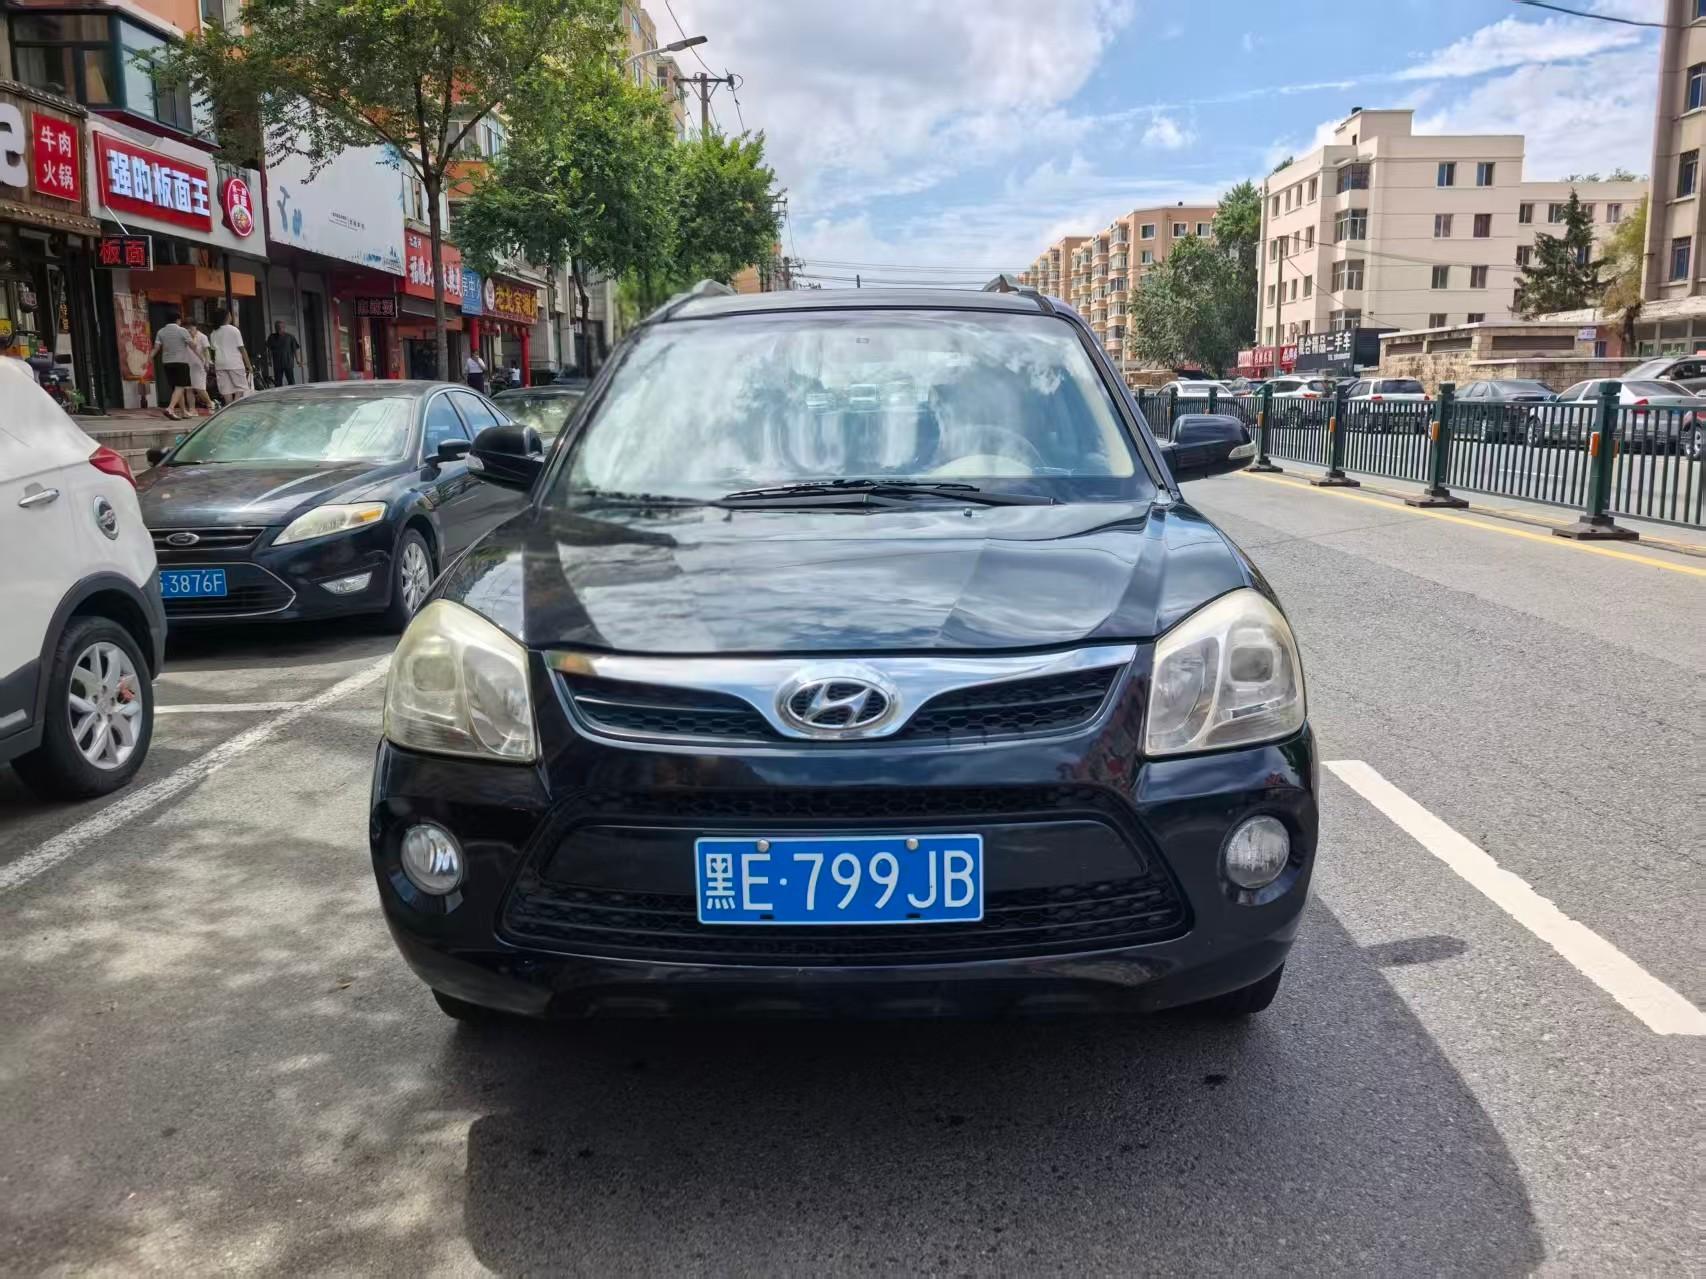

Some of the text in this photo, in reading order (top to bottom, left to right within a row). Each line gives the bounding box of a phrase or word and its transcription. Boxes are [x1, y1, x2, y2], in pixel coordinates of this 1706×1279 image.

[40, 125, 72, 158] 牛肉
[43, 160, 74, 191] 火锅
[108, 149, 210, 217] 强的板面王
[99, 238, 146, 266] 板面
[705, 850, 975, 911] 黑E·799JB
